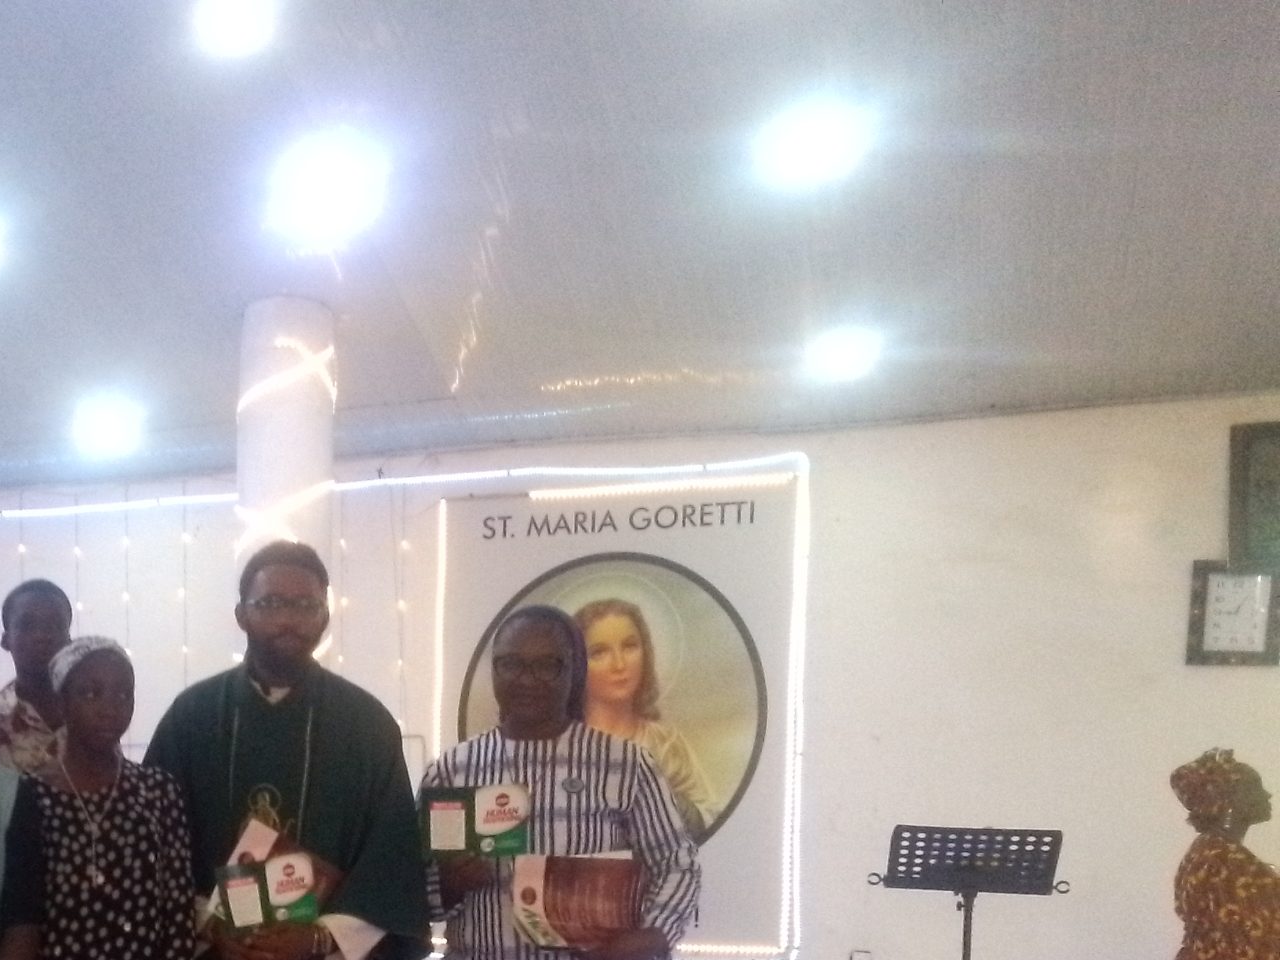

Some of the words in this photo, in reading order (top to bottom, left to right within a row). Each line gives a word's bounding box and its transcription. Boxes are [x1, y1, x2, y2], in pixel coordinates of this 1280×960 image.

[482, 515, 515, 540] ST.
[526, 509, 618, 537] MARIA
[628, 500, 756, 531] GORETTI
[486, 806, 519, 818] HUMAN
